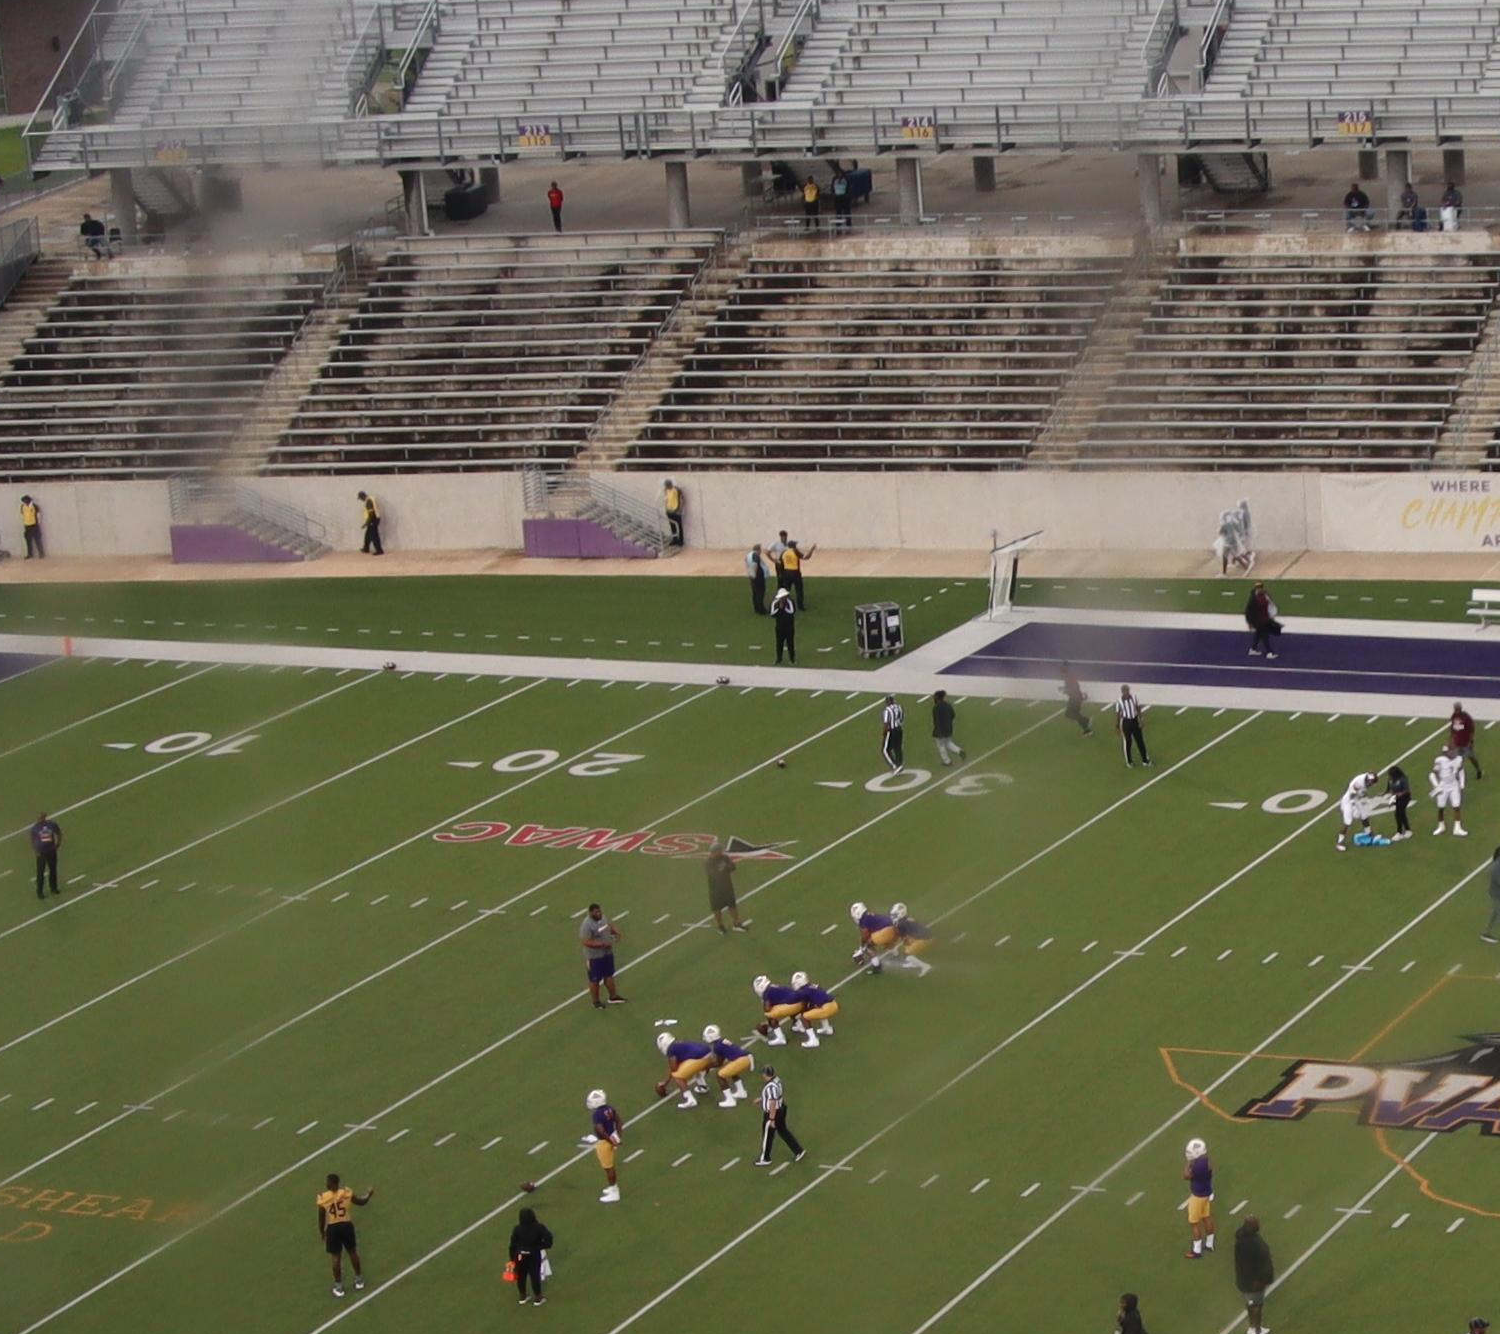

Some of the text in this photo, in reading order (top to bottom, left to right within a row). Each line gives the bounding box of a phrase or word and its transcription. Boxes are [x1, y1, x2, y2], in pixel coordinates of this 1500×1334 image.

[907, 116, 929, 127] 214
[524, 125, 546, 136] 213
[910, 127, 929, 138] 116
[1346, 122, 1366, 133] 117
[1430, 480, 1491, 493] WHERE
[432, 820, 718, 859] SWAC
[329, 1201, 346, 1219] 45
